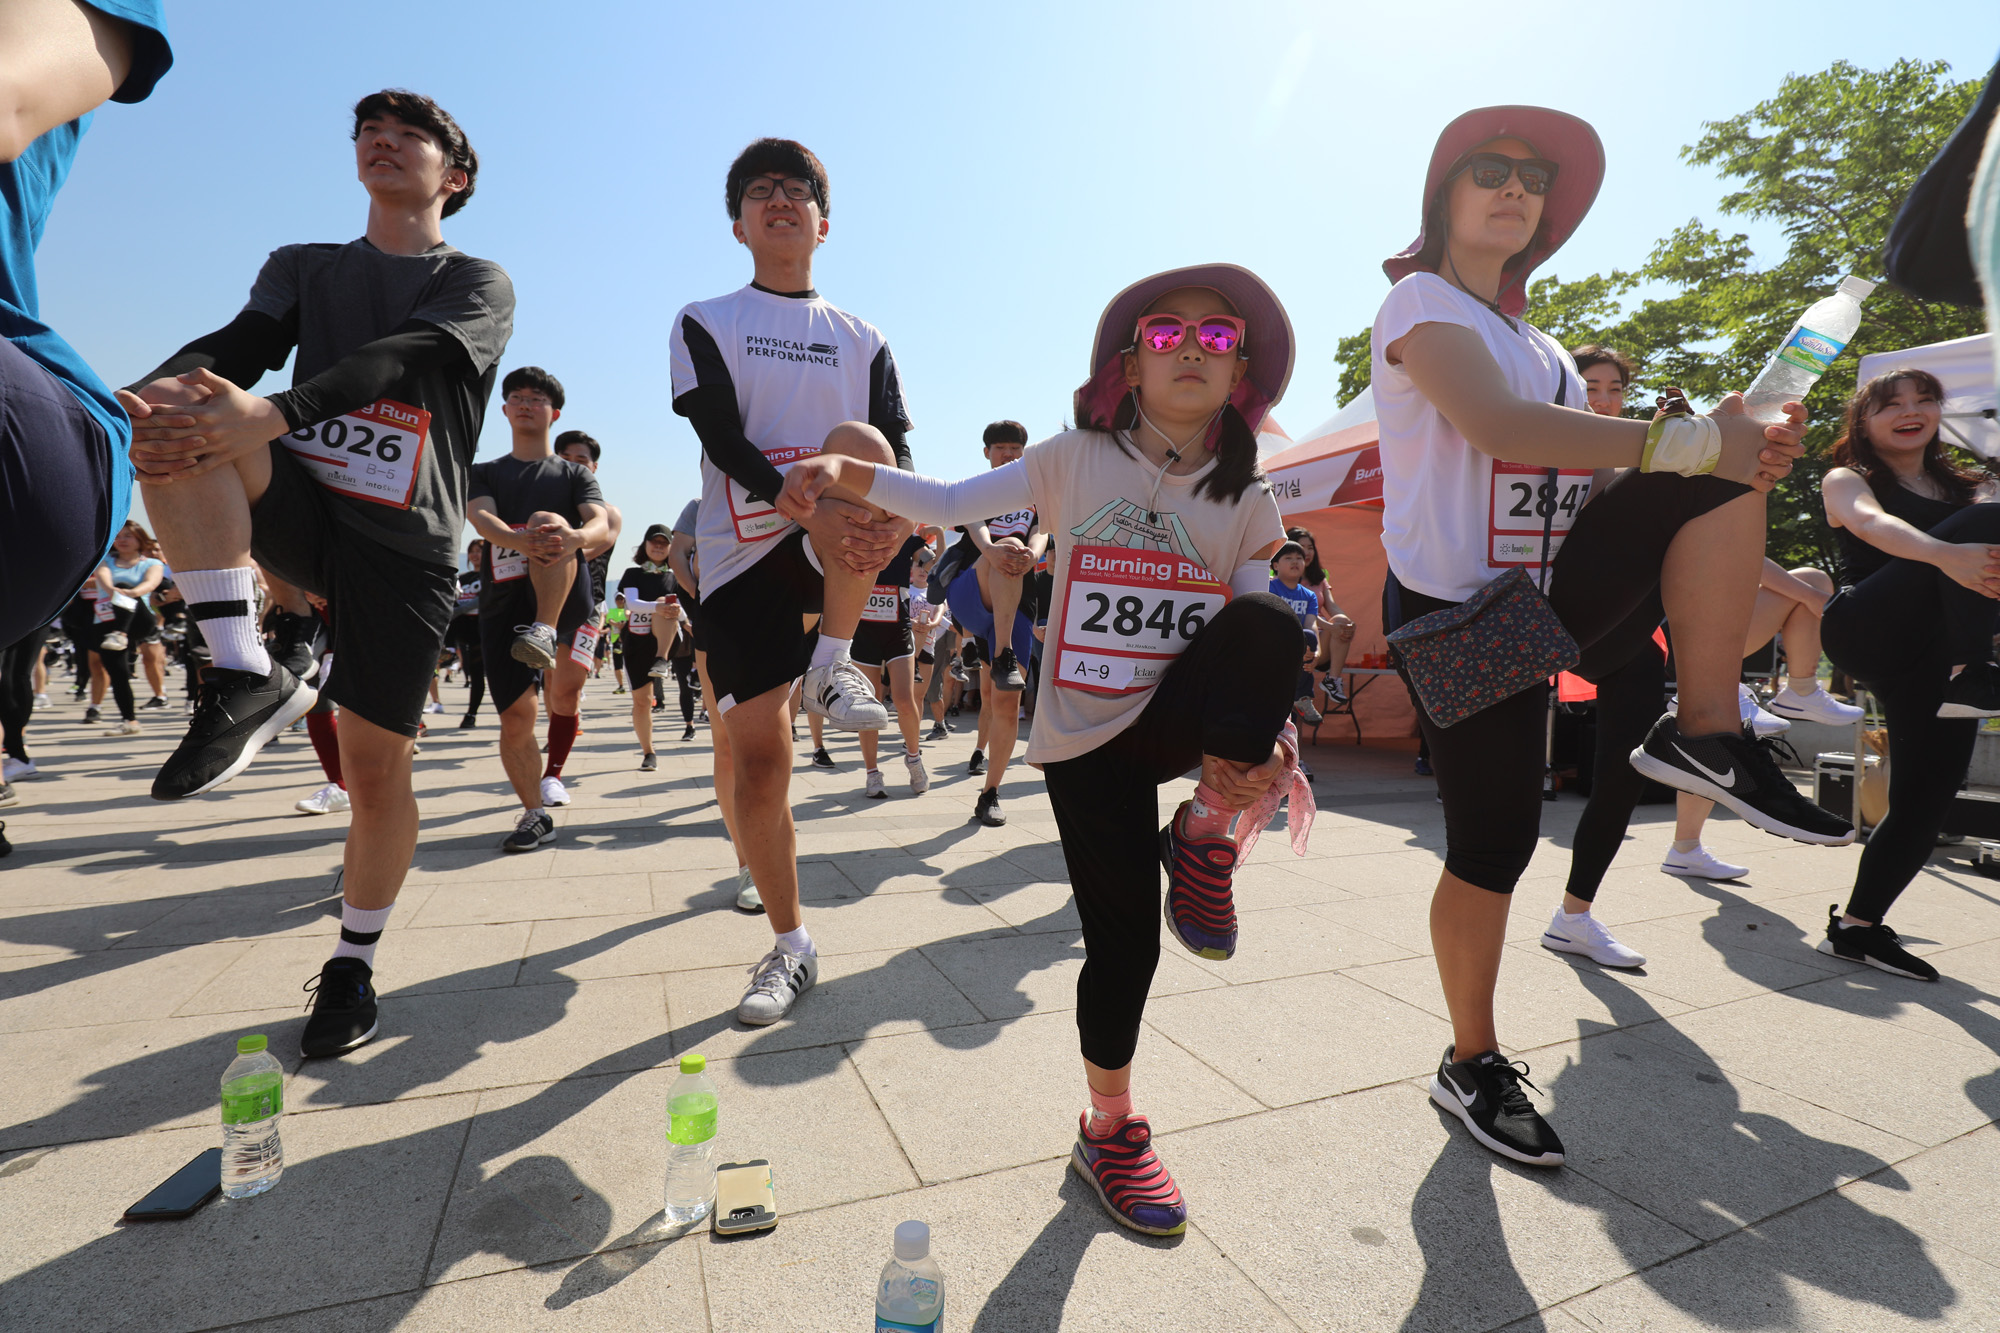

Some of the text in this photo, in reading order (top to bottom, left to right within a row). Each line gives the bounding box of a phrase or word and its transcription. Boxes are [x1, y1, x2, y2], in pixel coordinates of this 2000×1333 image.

[746, 335, 806, 351] PHYSICAL
[746, 346, 839, 368] PERFORMANCE
[379, 403, 419, 425] Run
[799, 447, 821, 455] Ru
[1509, 482, 1590, 518] 2847
[1080, 554, 1219, 582] Burning Run
[867, 596, 894, 607] 056
[1081, 592, 1205, 640] 2846
[1074, 661, 1110, 679] A-9
[1134, 665, 1157, 677] iclan
